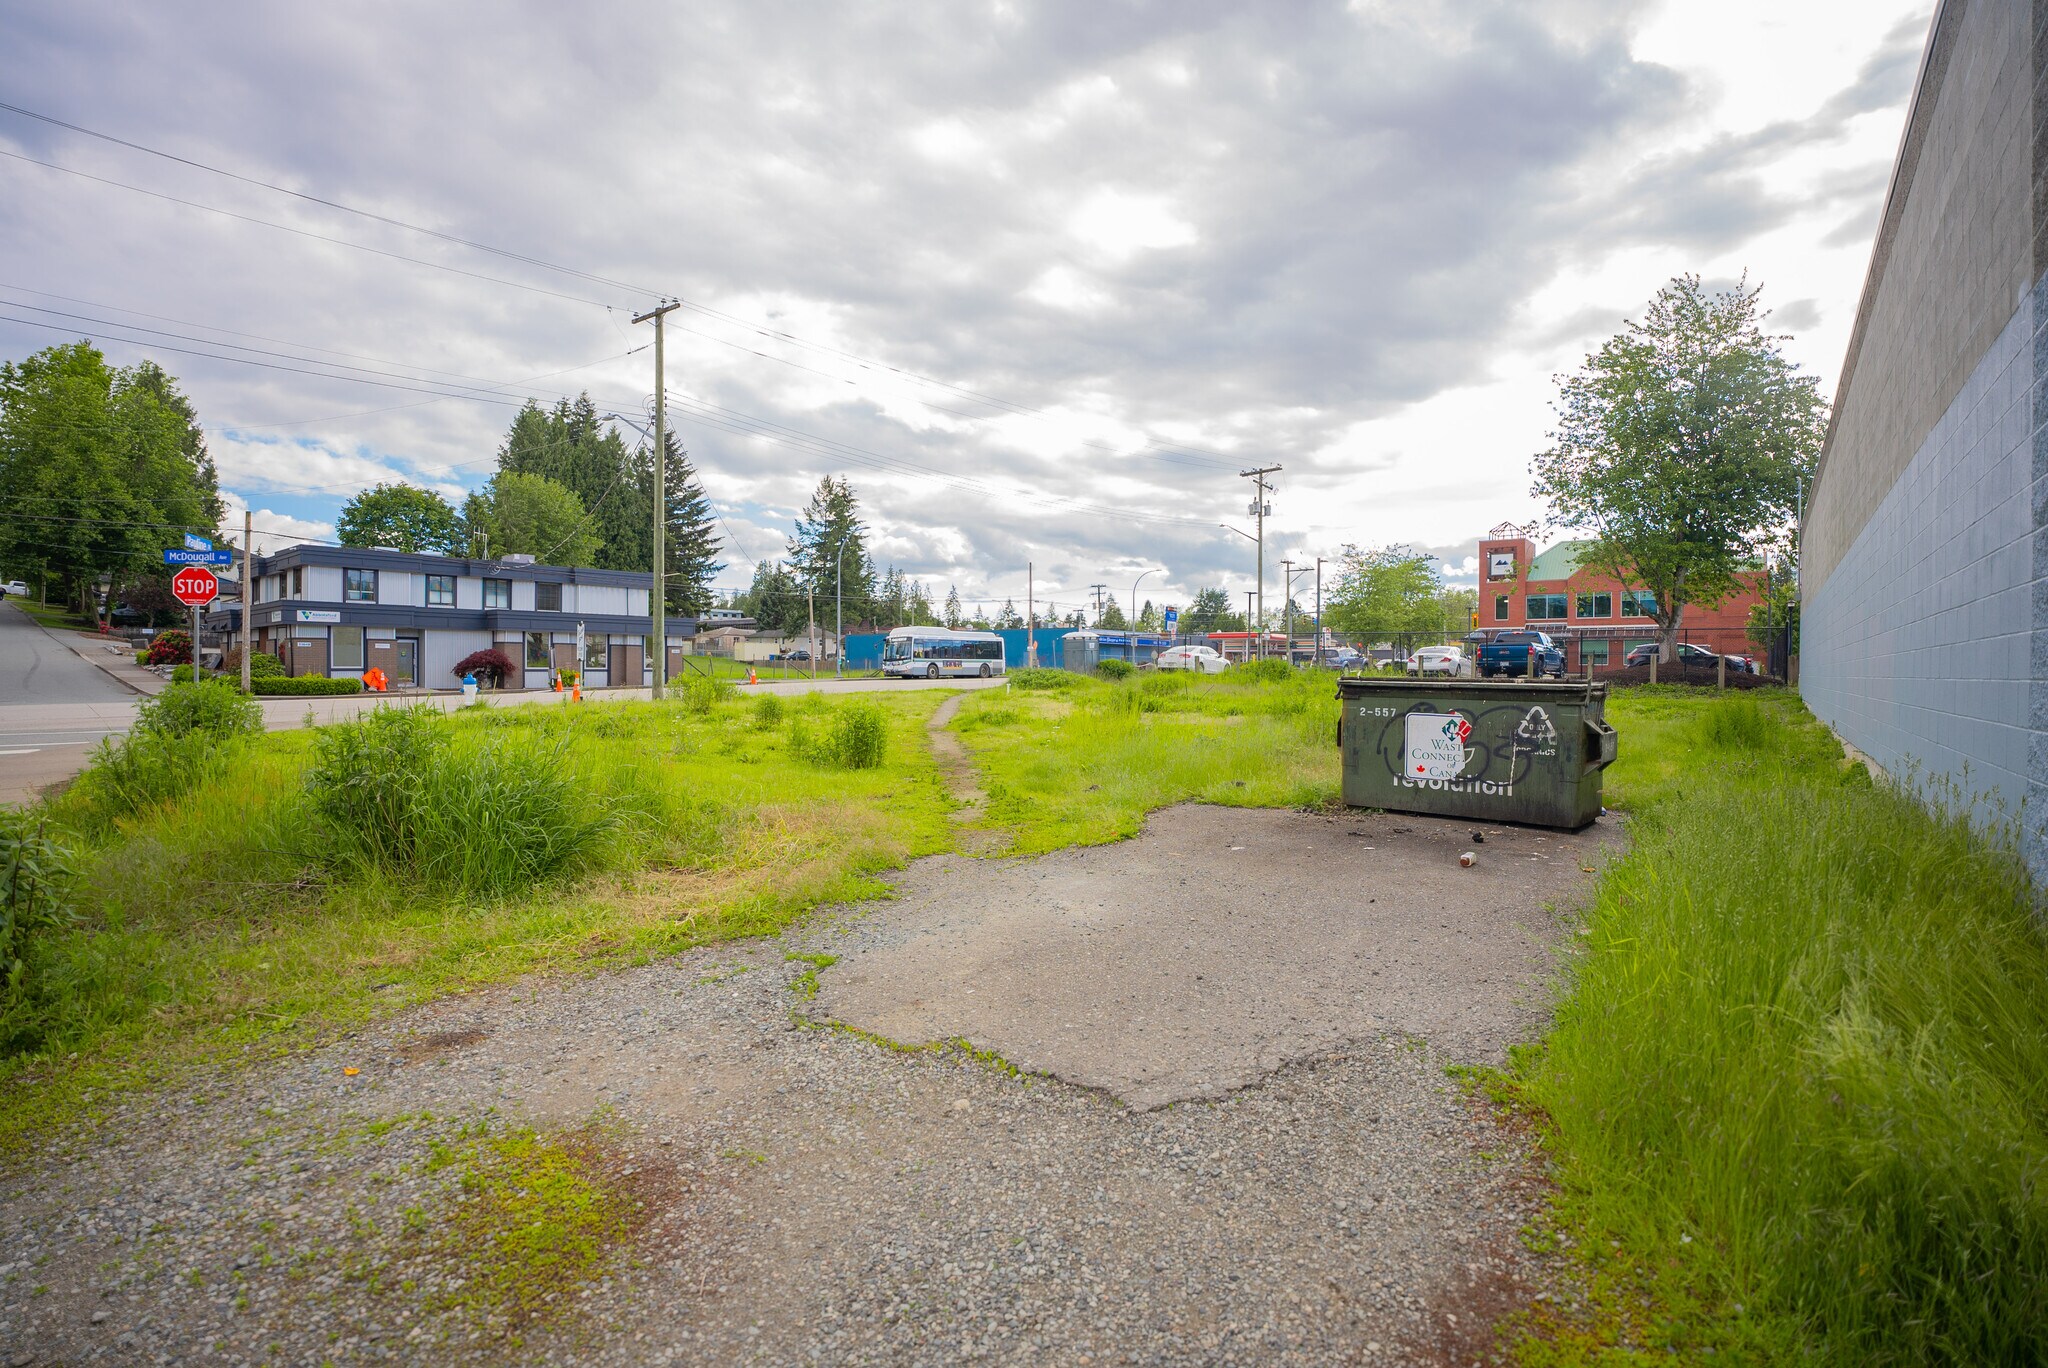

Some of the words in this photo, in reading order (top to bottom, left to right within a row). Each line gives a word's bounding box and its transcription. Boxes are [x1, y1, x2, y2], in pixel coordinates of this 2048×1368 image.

[169, 552, 215, 562] McDougall
[177, 579, 214, 594] STOP
[1360, 707, 1396, 717] 2-557
[1431, 739, 1461, 752] WAST
[1412, 748, 1465, 762] CONNEC
